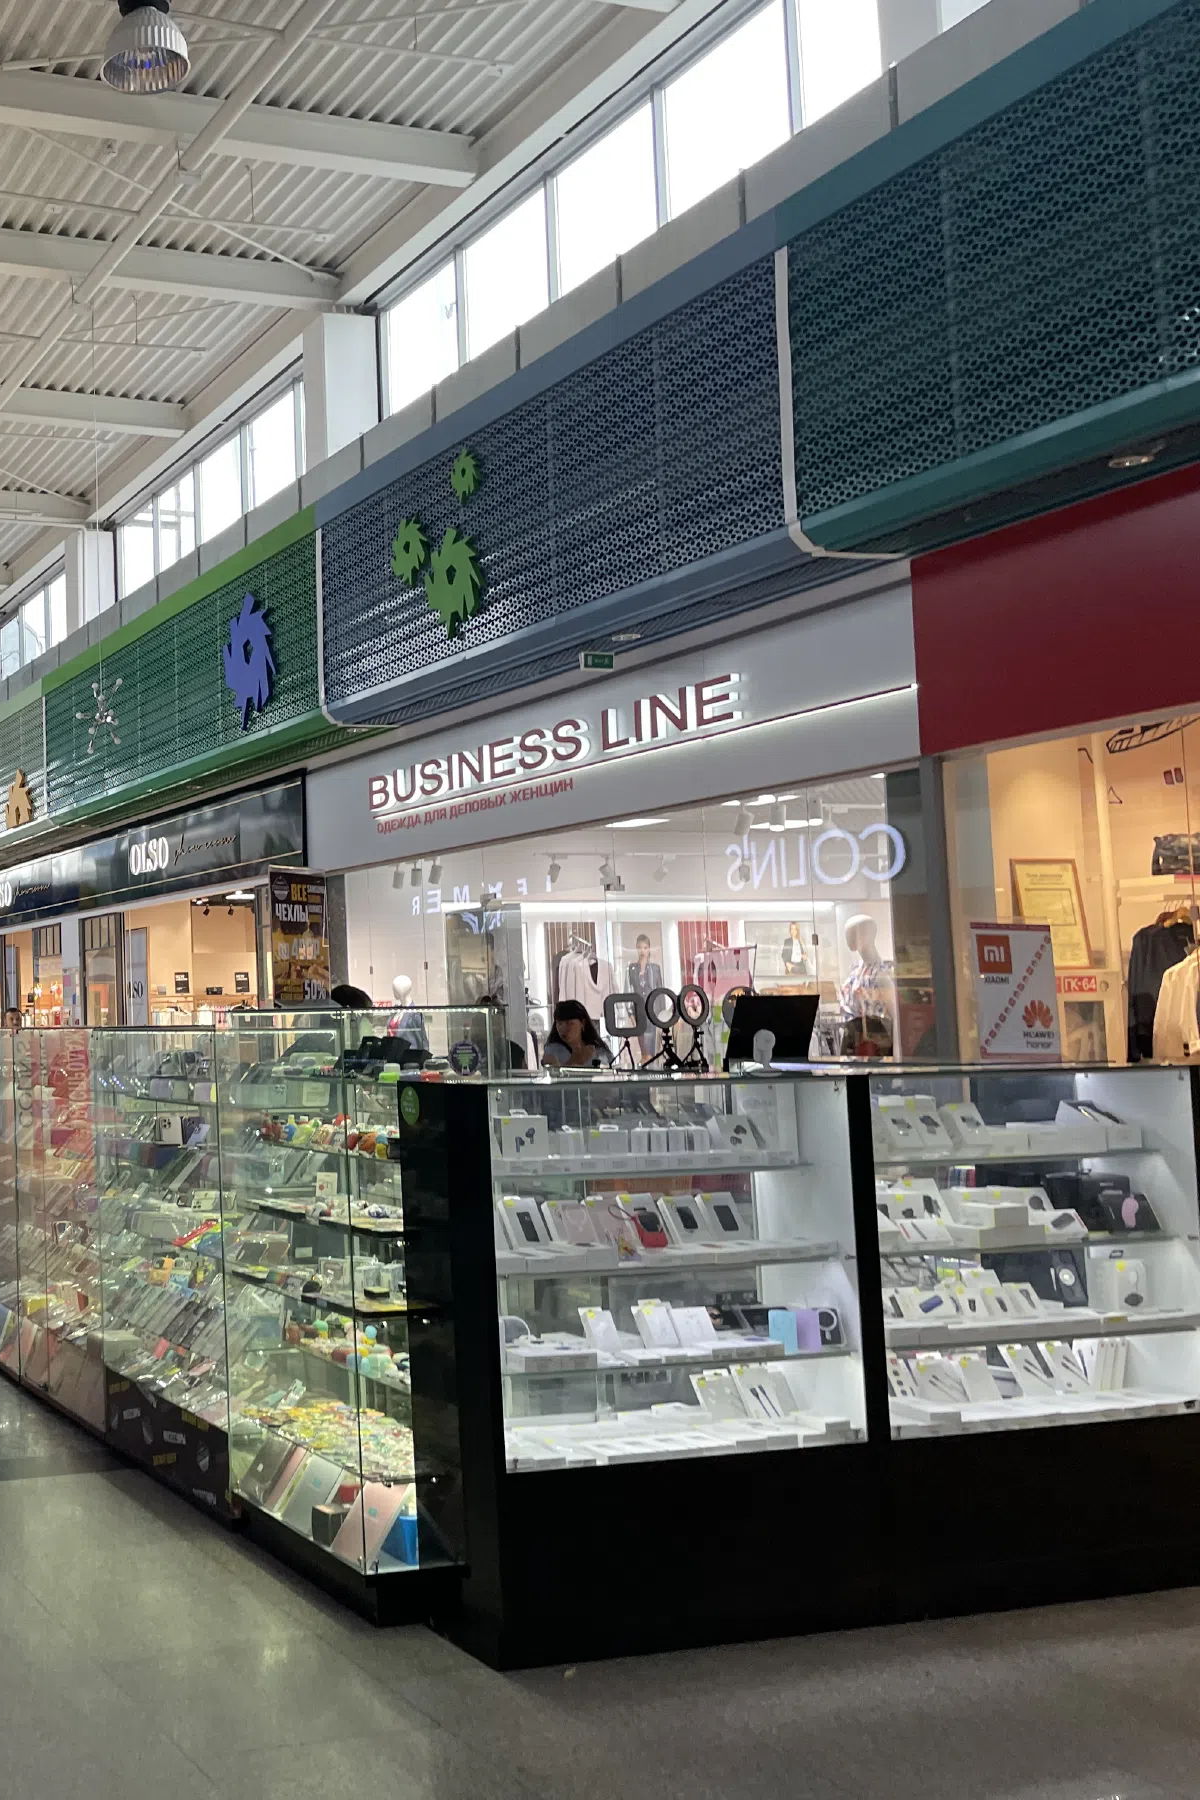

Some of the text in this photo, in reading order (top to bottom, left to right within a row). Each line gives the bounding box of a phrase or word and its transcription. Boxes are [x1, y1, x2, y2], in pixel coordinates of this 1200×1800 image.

[369, 673, 742, 812] BUSINESS LINE
[377, 777, 574, 834] ОДЕЖДА ДЛЯ ДЕЛОВЫХ ЖЕНЩИН
[129, 836, 169, 876] OLSO
[291, 884, 307, 901] ВСЕ
[275, 903, 309, 922] ЧЕХЛЫ
[304, 980, 327, 1000] 50%
[984, 975, 1010, 985] XIAOMI
